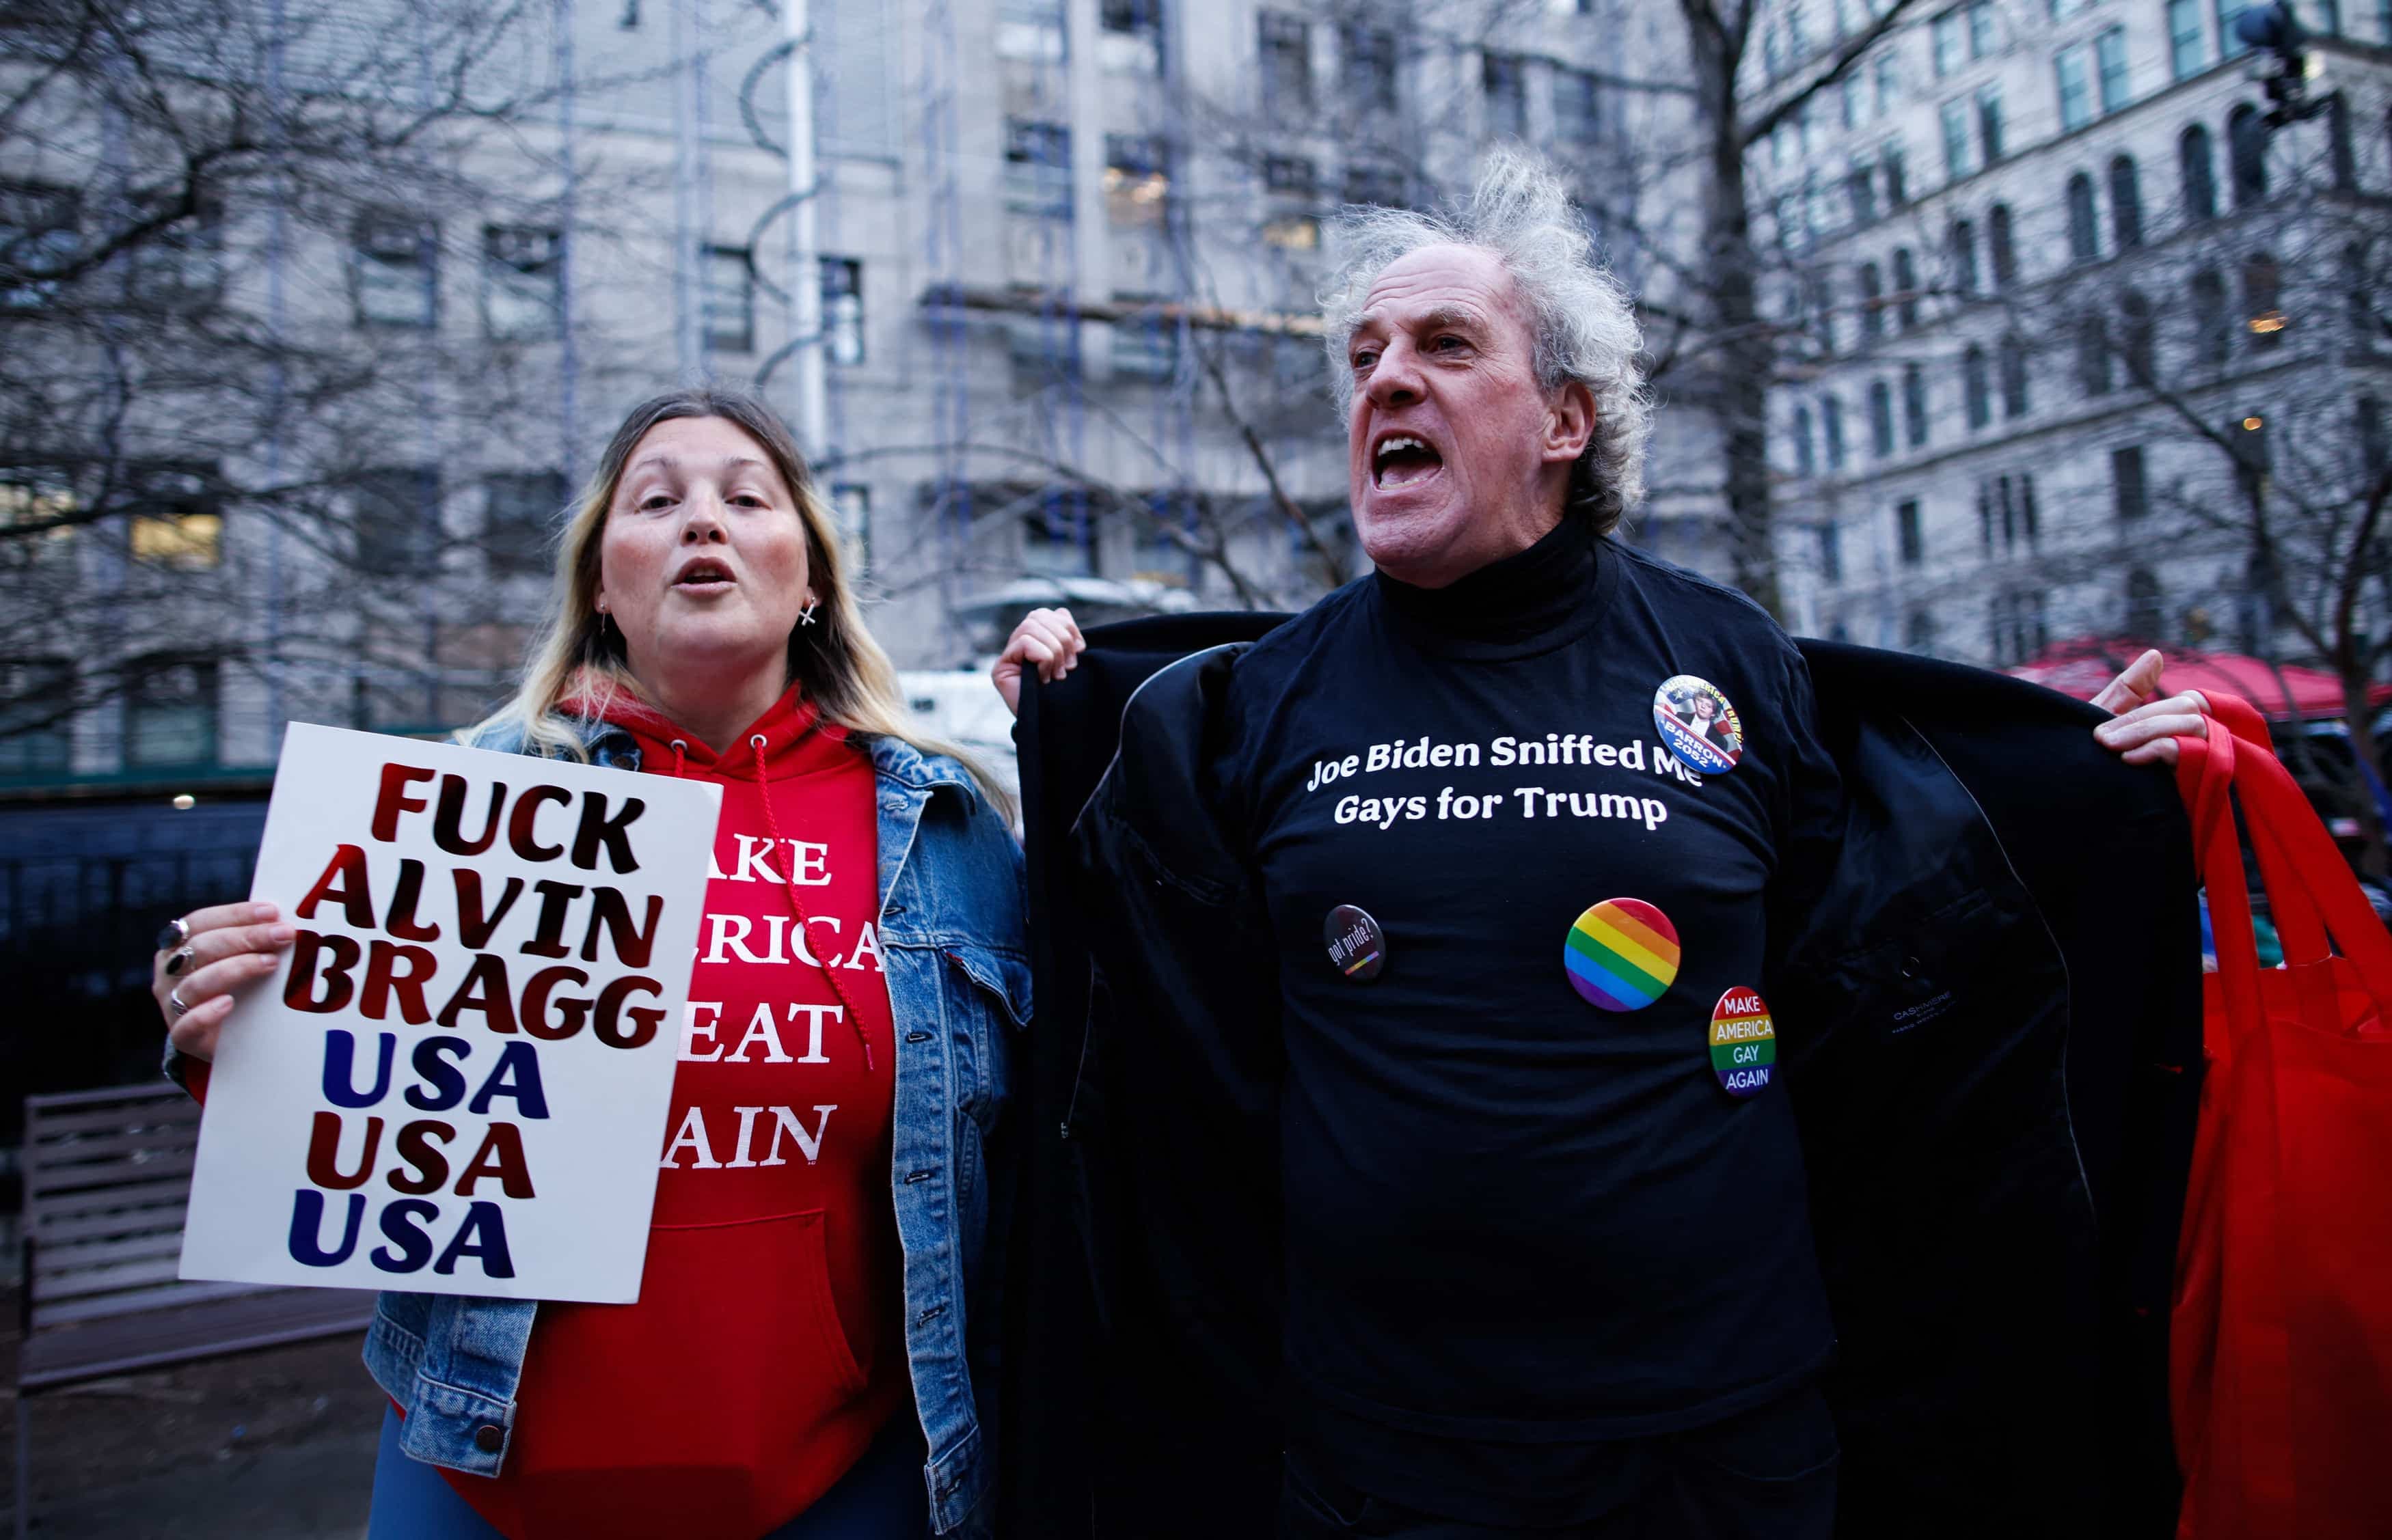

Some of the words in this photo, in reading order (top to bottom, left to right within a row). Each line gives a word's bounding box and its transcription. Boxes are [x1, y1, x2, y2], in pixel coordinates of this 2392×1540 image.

[1307, 755, 1359, 792] Joe
[1365, 736, 1480, 773] Biden
[1490, 733, 1646, 771] Sniffed
[1664, 721, 1724, 768] BARRON
[1672, 739, 1709, 768] 2052
[371, 762, 646, 875] FUCK
[1334, 795, 1426, 830] Gays
[1437, 786, 1503, 820] for
[1513, 786, 1668, 831] Trump
[706, 833, 832, 886] KE
[295, 844, 664, 969] ALVIN
[692, 913, 886, 973] RICA
[1328, 938, 1346, 967] got
[1342, 918, 1374, 957] pride?
[282, 929, 667, 1049] BRAGG
[1724, 995, 1761, 1015] MAKE
[677, 1001, 844, 1064] EAT
[1716, 1019, 1773, 1041] AMERICA
[1732, 1045, 1759, 1064] GAY
[321, 1029, 550, 1120] USA
[1725, 1068, 1769, 1090] AGAIN
[305, 1110, 536, 1200] USA
[661, 1104, 838, 1169] AIN
[287, 1188, 516, 1279] USA
